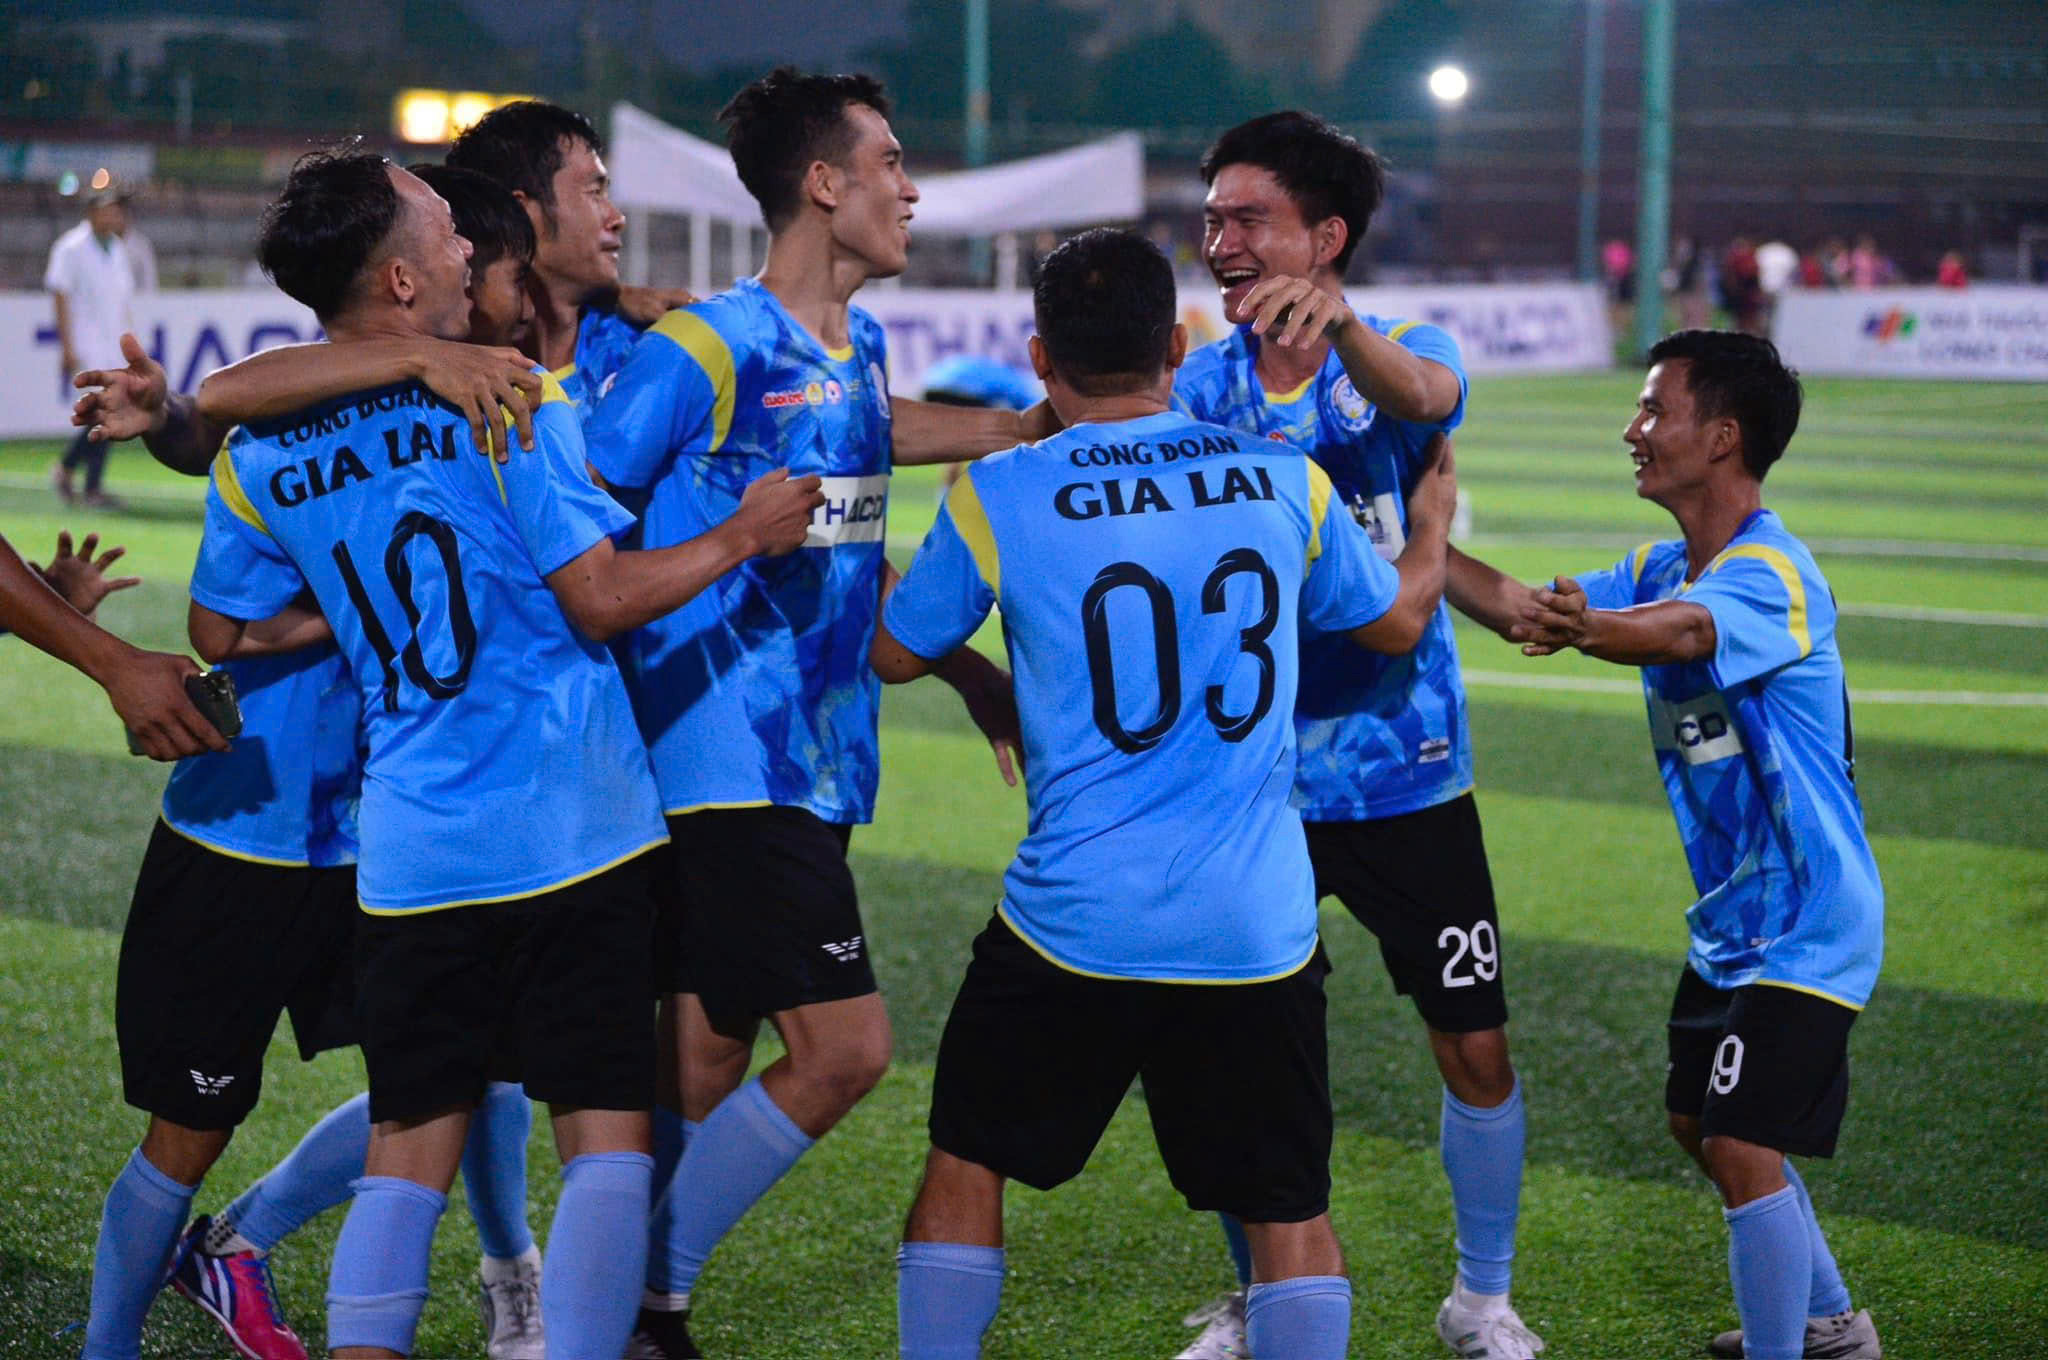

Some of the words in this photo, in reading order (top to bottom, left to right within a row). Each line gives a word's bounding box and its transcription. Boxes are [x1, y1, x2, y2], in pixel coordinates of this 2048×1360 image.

[269, 445, 375, 508] GIA
[382, 421, 457, 470] LAI
[1070, 442, 1153, 467] CÔNG
[1053, 476, 1175, 521] GIA
[1185, 466, 1276, 508] LAI
[331, 511, 477, 713] 10
[1081, 547, 1280, 755] 03
[1438, 919, 1499, 988] 29
[1705, 1034, 1745, 1096] 9
